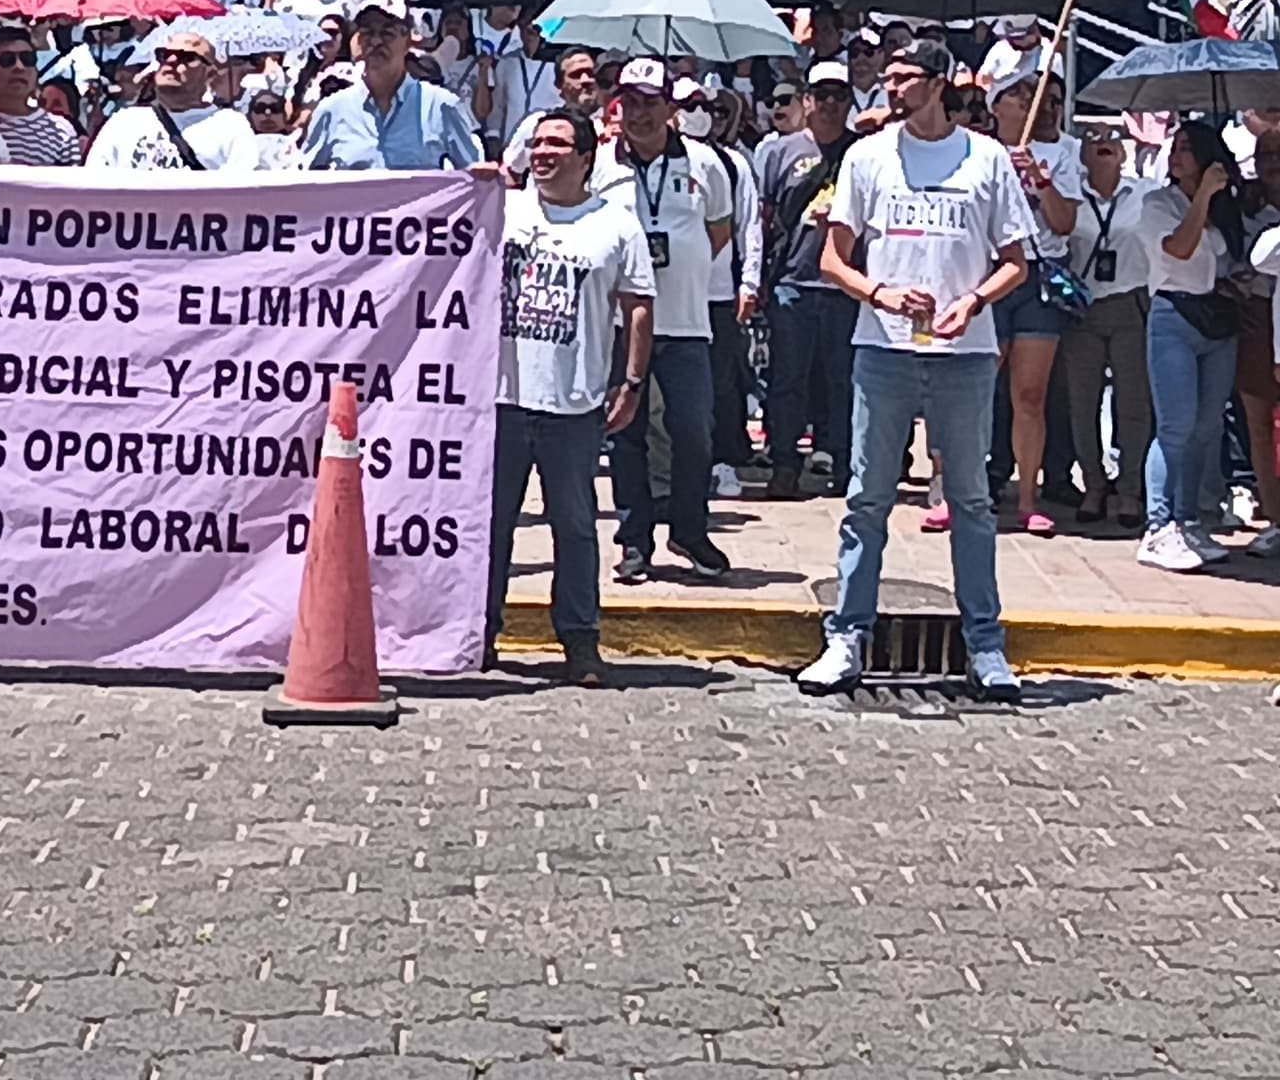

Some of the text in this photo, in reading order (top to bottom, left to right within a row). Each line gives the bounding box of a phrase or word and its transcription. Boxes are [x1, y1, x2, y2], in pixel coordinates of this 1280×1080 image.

[27, 209, 228, 252] POPULAR
[242, 214, 298, 253] DE
[311, 215, 474, 258] JUECES
[178, 285, 379, 330] ELIMINA
[415, 290, 470, 330] LA
[163, 359, 192, 398] Y
[418, 363, 467, 405] EL
[23, 429, 392, 480] OPORTUNIDAS
[408, 439, 463, 480] DE
[40, 507, 250, 554] LABORAL
[286, 513, 312, 555] D
[374, 514, 459, 559] LOS
